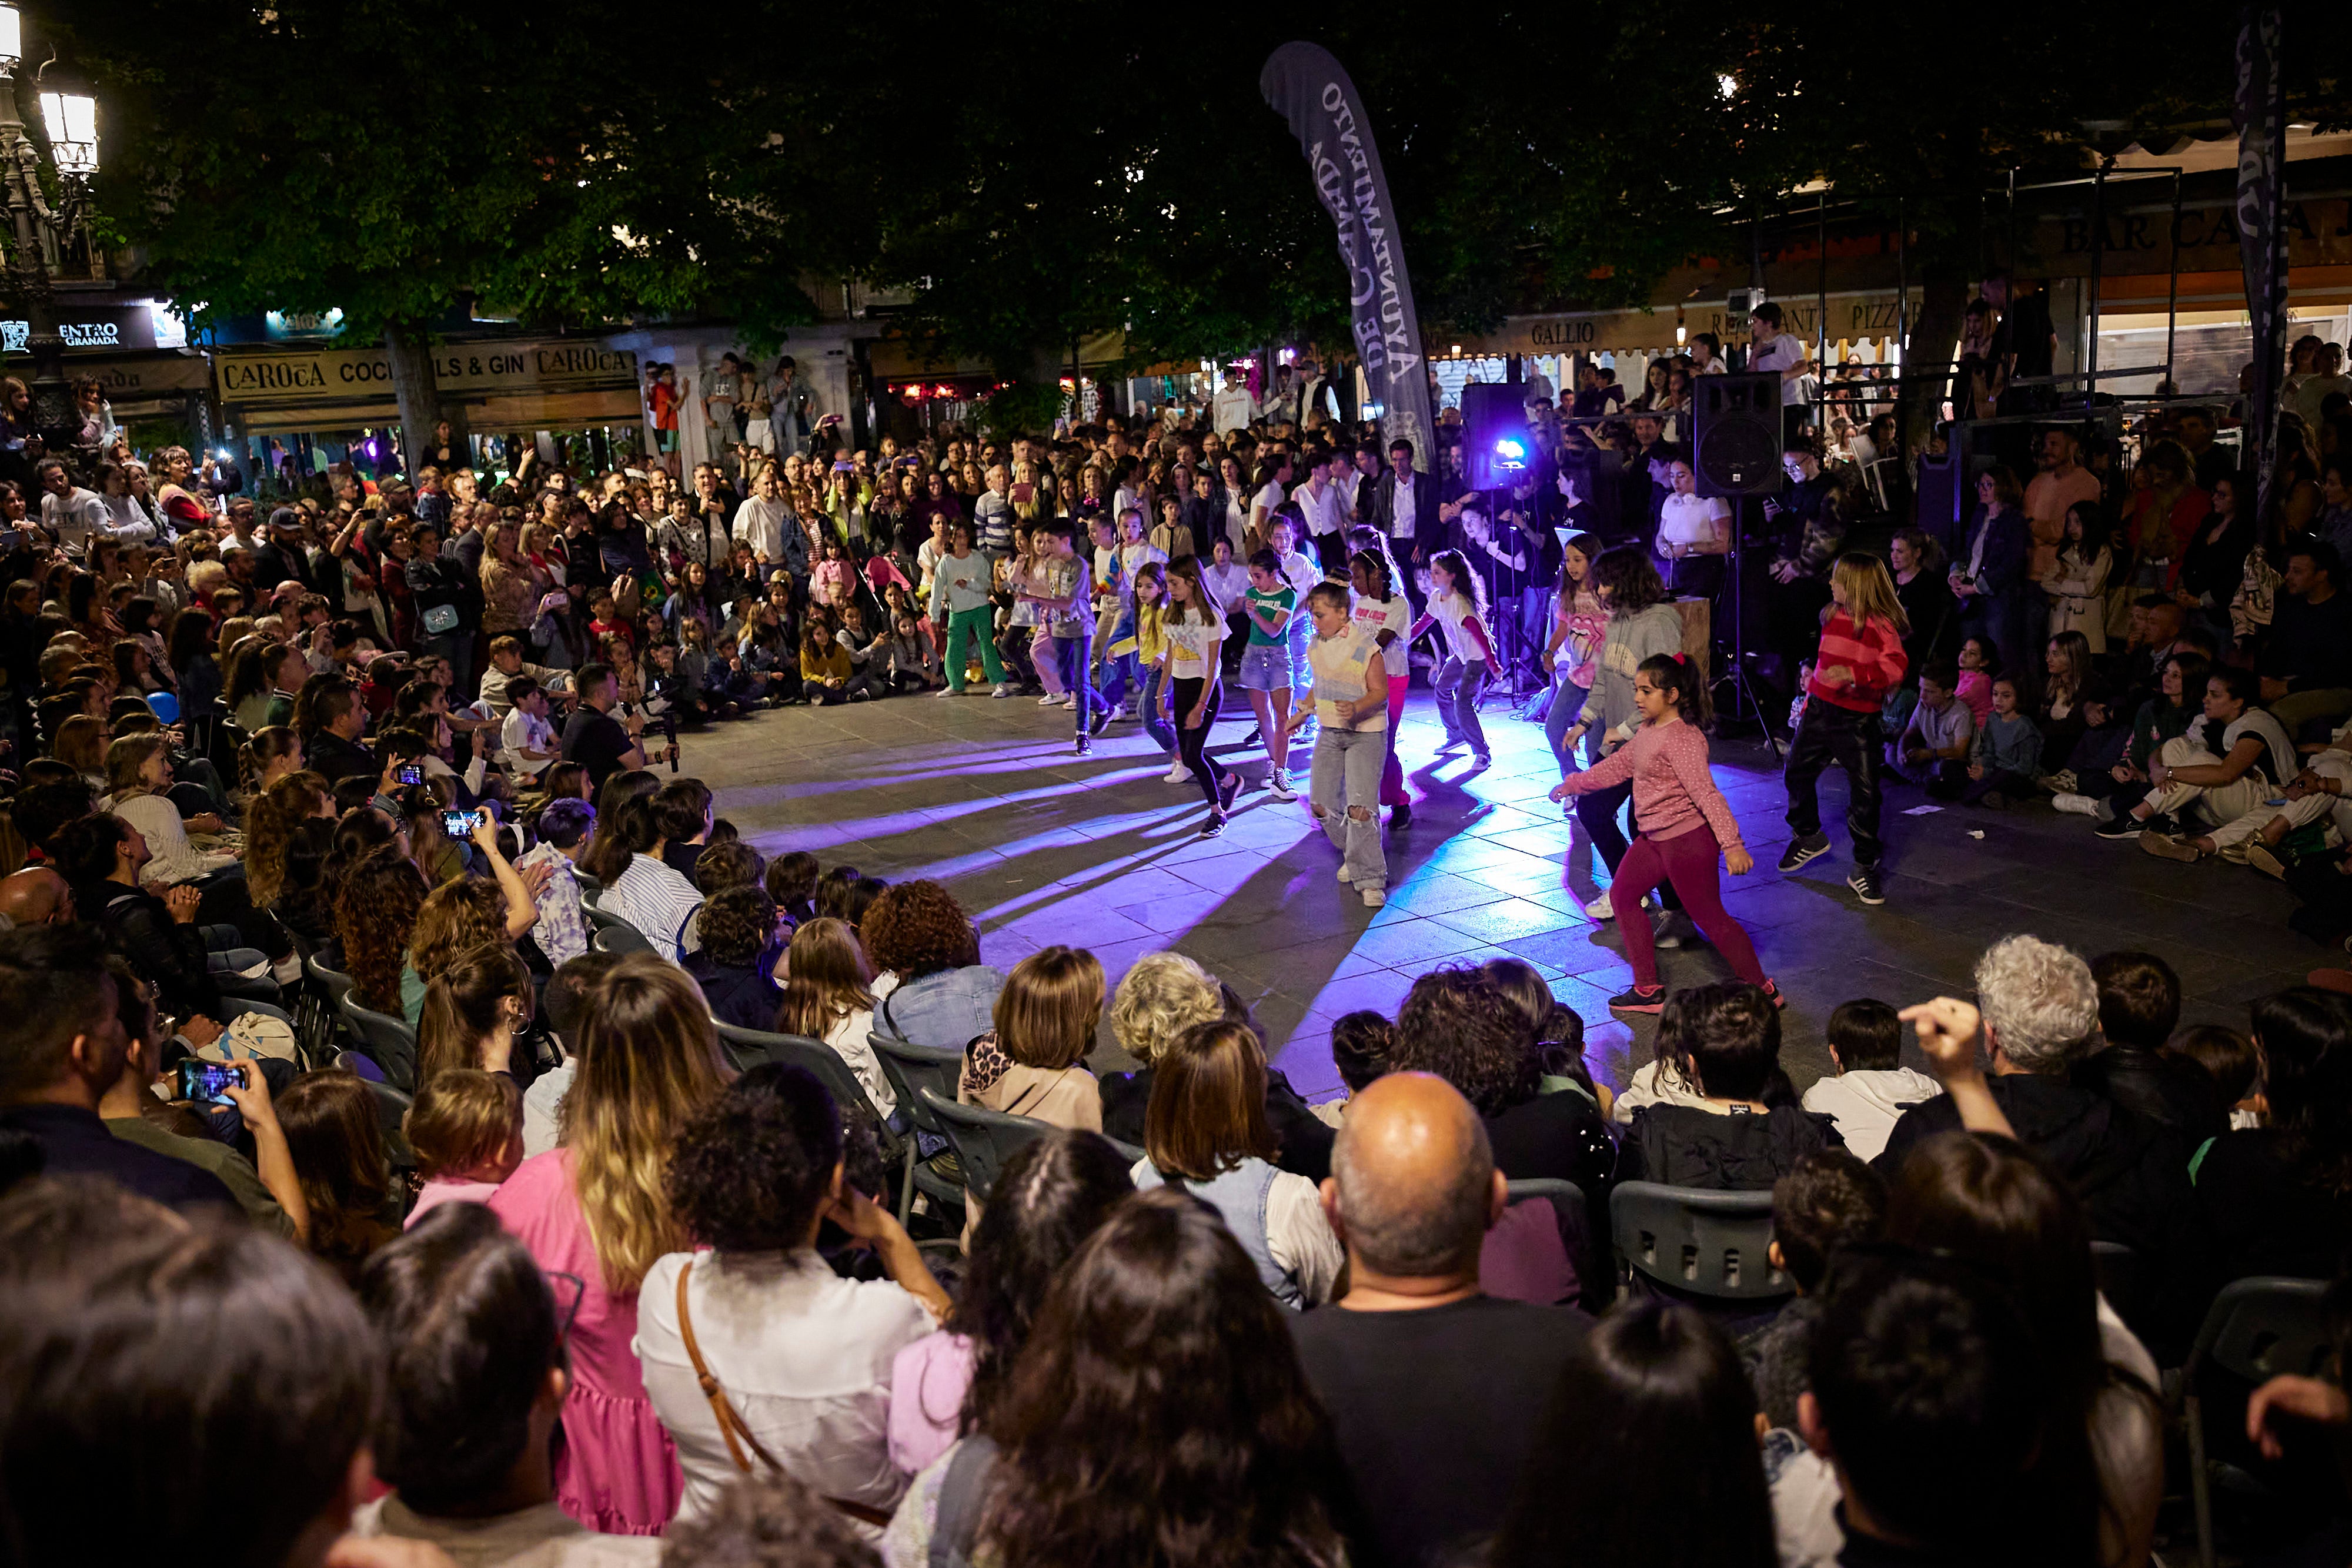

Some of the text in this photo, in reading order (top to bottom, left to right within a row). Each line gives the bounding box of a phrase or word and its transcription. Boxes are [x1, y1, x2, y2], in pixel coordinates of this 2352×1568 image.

[2062, 215, 2156, 253] BAR
[2171, 202, 2317, 248] CAA
[65, 336, 119, 346] GRANADA
[1532, 322, 1593, 345] GALLIO
[224, 361, 326, 389] CAROCA
[469, 356, 482, 375] &
[489, 355, 524, 375] GIN
[537, 347, 627, 375] CAROCA
